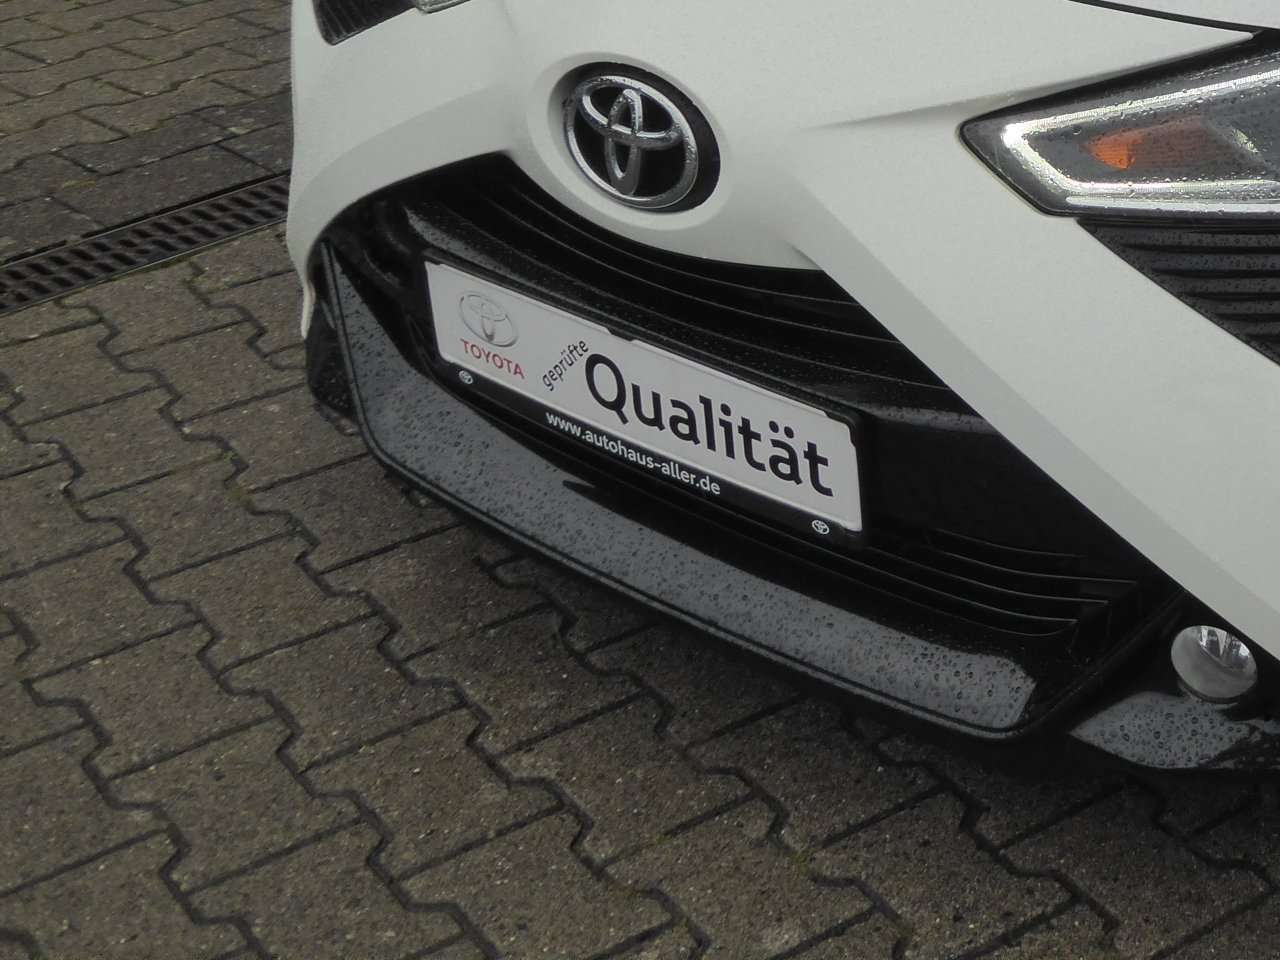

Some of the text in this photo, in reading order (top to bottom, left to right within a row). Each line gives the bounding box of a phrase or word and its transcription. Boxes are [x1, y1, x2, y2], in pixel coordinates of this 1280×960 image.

[460, 338, 525, 379] TOYOTA
[542, 340, 833, 497] geprüfte Qualität
[545, 411, 721, 495] www.autohaus-aller.de
